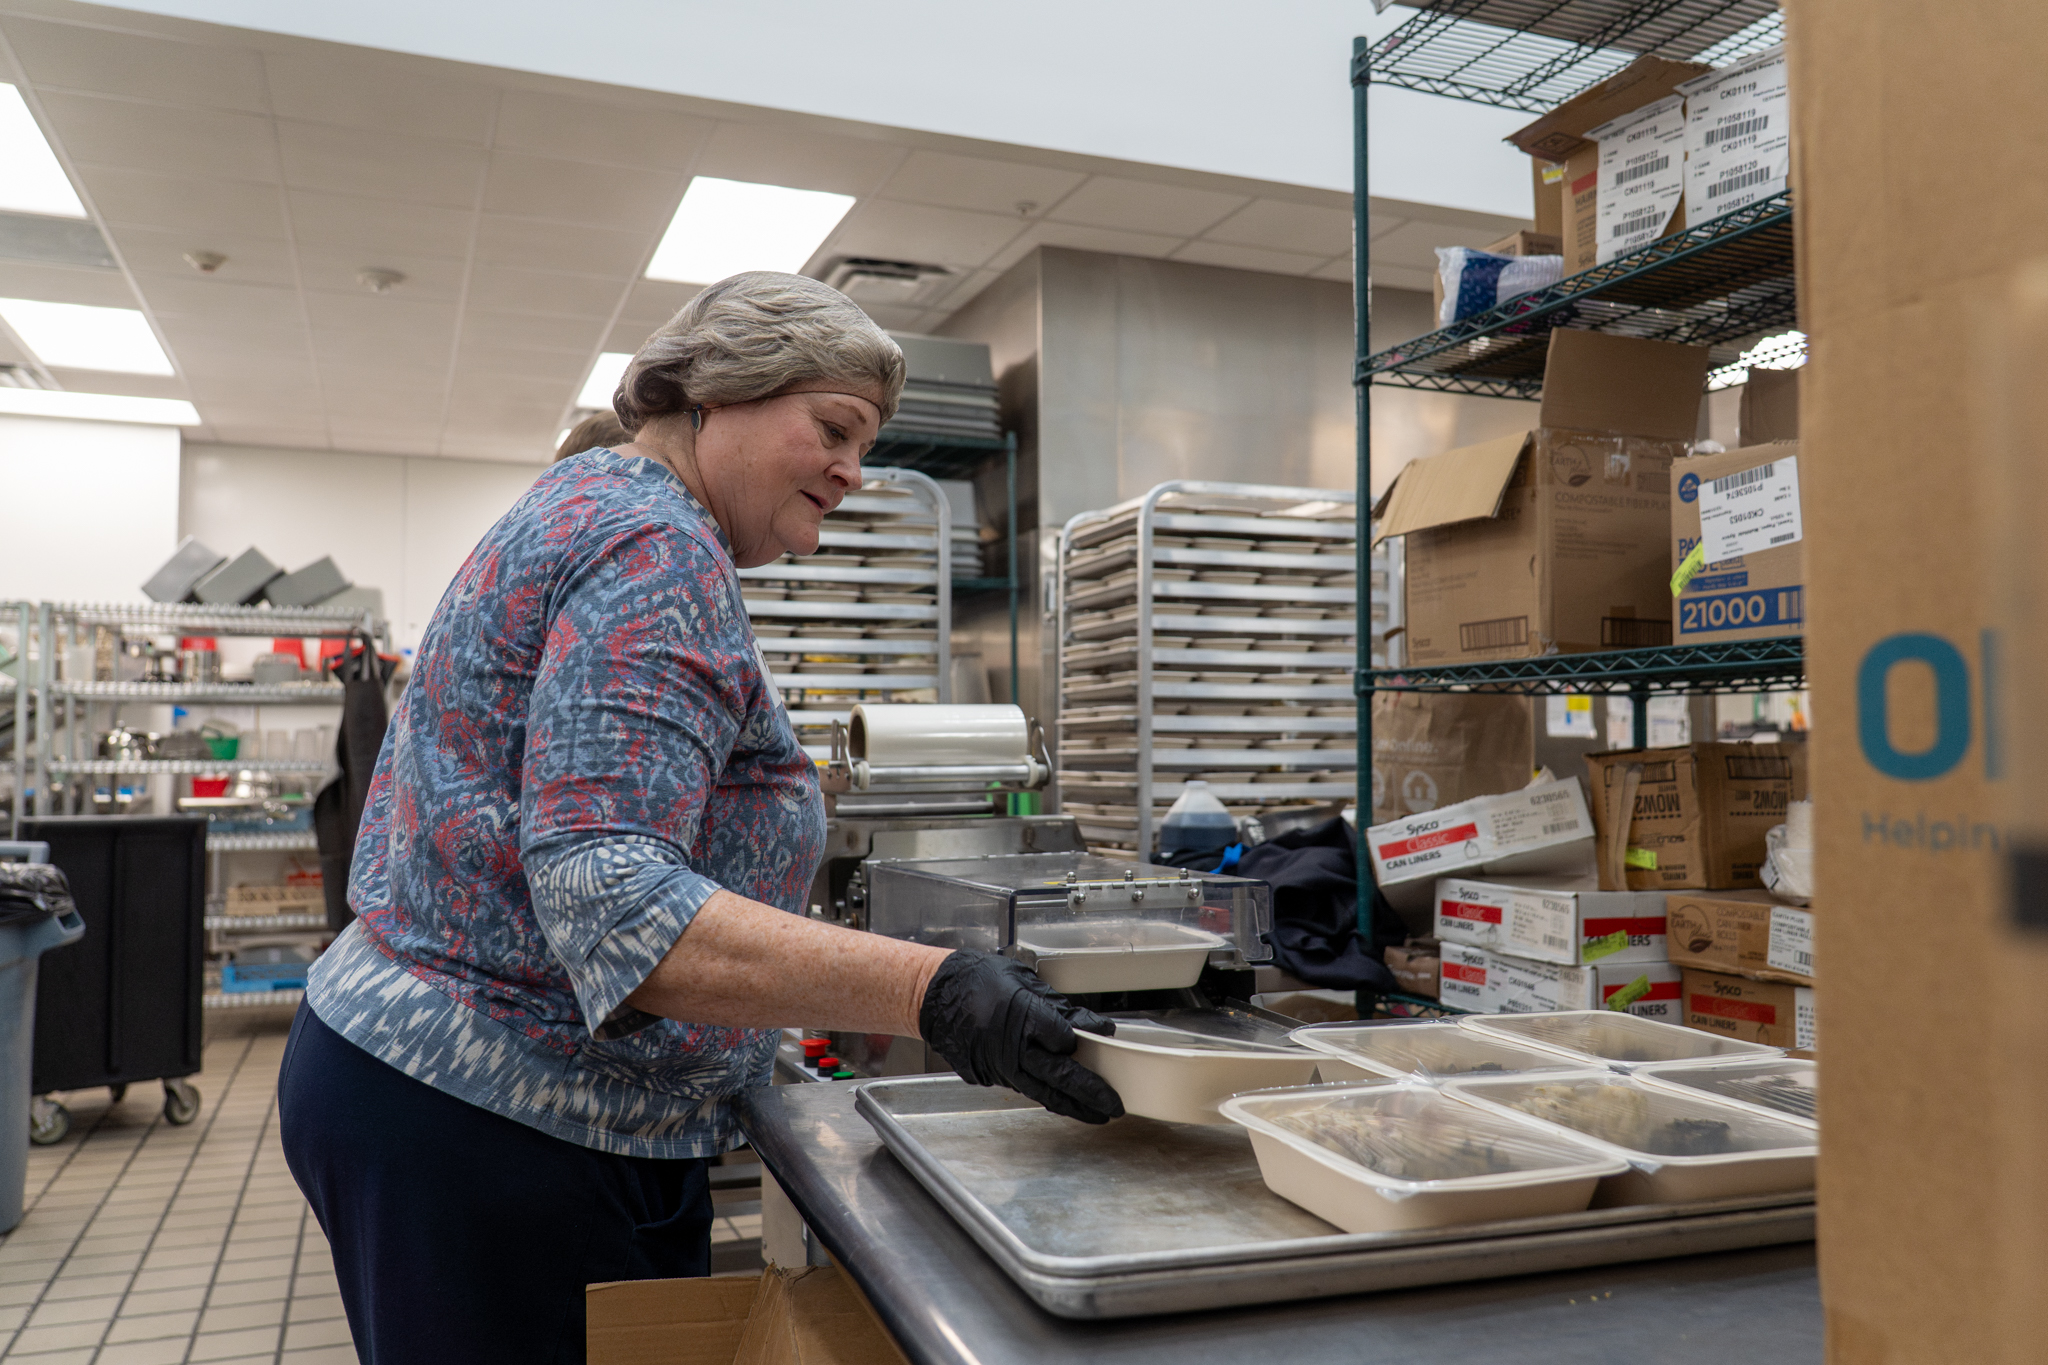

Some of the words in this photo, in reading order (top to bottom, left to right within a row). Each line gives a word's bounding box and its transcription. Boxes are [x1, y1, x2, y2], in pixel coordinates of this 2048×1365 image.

[1720, 81, 1757, 100] CK01119
[1717, 108, 1756, 126] P1058119
[1626, 125, 1657, 143] CK01119
[1720, 134, 1757, 154] CK01119
[1625, 149, 1658, 167] P1058122
[1719, 160, 1758, 179] P1058120
[1574, 189, 1597, 206] HAIR
[1716, 193, 1755, 214] P1058121
[1622, 204, 1655, 220] P1058123
[1726, 483, 1763, 500] P1053674
[1729, 508, 1764, 525] CK01053
[1683, 594, 1766, 630] 21000
[1634, 793, 1680, 814] MOW2
[1753, 790, 1787, 810] MOW2
[1405, 820, 1439, 837] Sysco
[1860, 806, 2003, 856] Helpin
[1406, 832, 1450, 853] Classic
[1386, 855, 1407, 870] CAN
[1408, 850, 1442, 866] LINERS
[1458, 887, 1479, 901] Sysco
[1456, 902, 1485, 921] Classic
[1440, 917, 1453, 928] CAN
[1453, 919, 1475, 932] LINERS
[1716, 920, 1731, 929] CAN
[1461, 951, 1484, 966] Sysco
[1443, 980, 1457, 991] CAN
[1457, 983, 1480, 996] LINERS
[1713, 980, 1742, 997] Sysco
[1631, 1003, 1668, 1016] LINERS
[1690, 1014, 1708, 1026] CAN
[1708, 1017, 1737, 1032] LINERS
